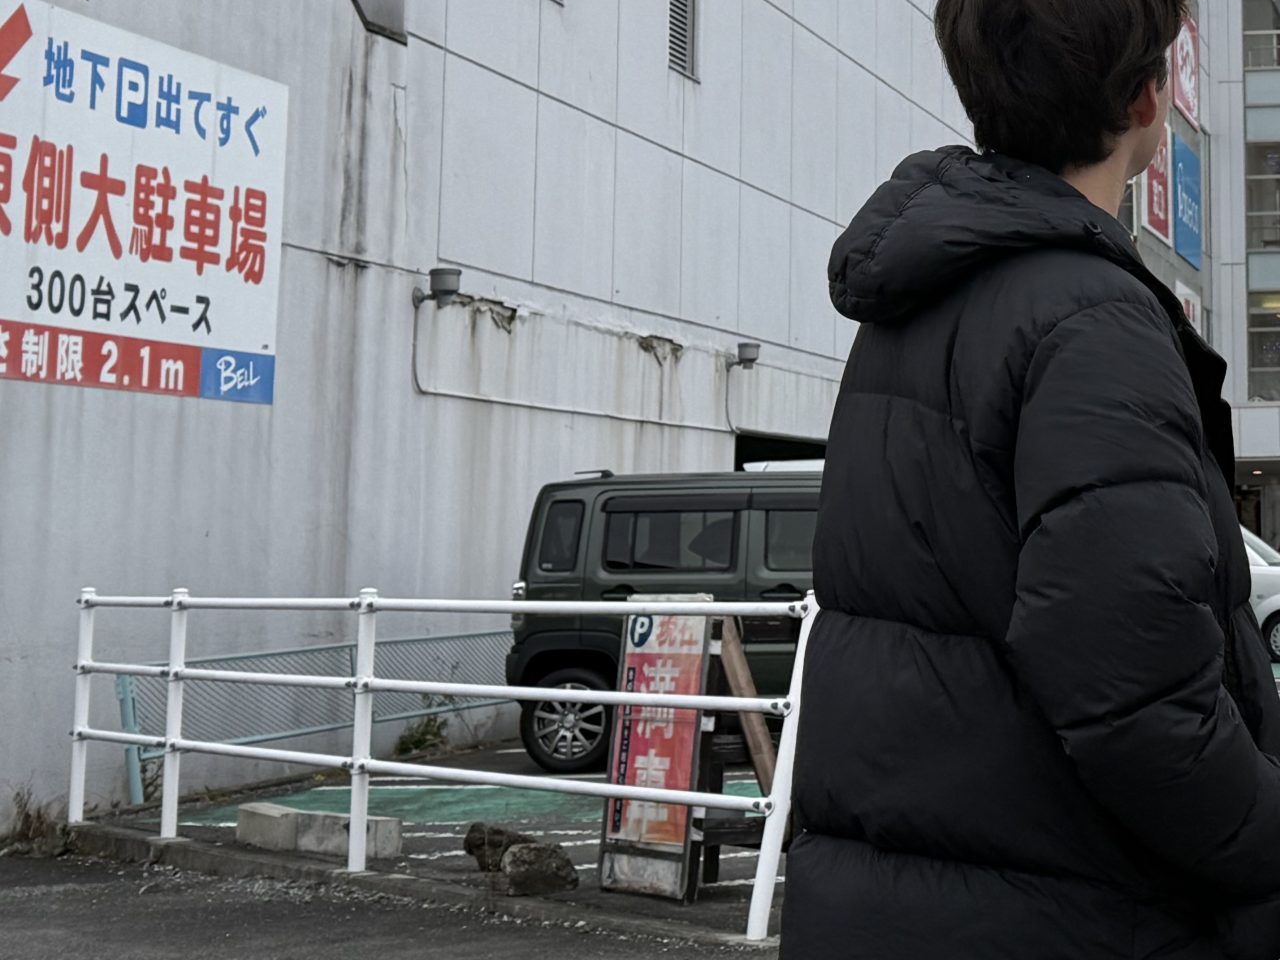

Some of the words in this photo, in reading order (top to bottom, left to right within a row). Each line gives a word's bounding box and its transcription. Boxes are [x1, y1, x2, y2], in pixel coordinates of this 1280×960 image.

[26, 265, 212, 335] 300台スペース
